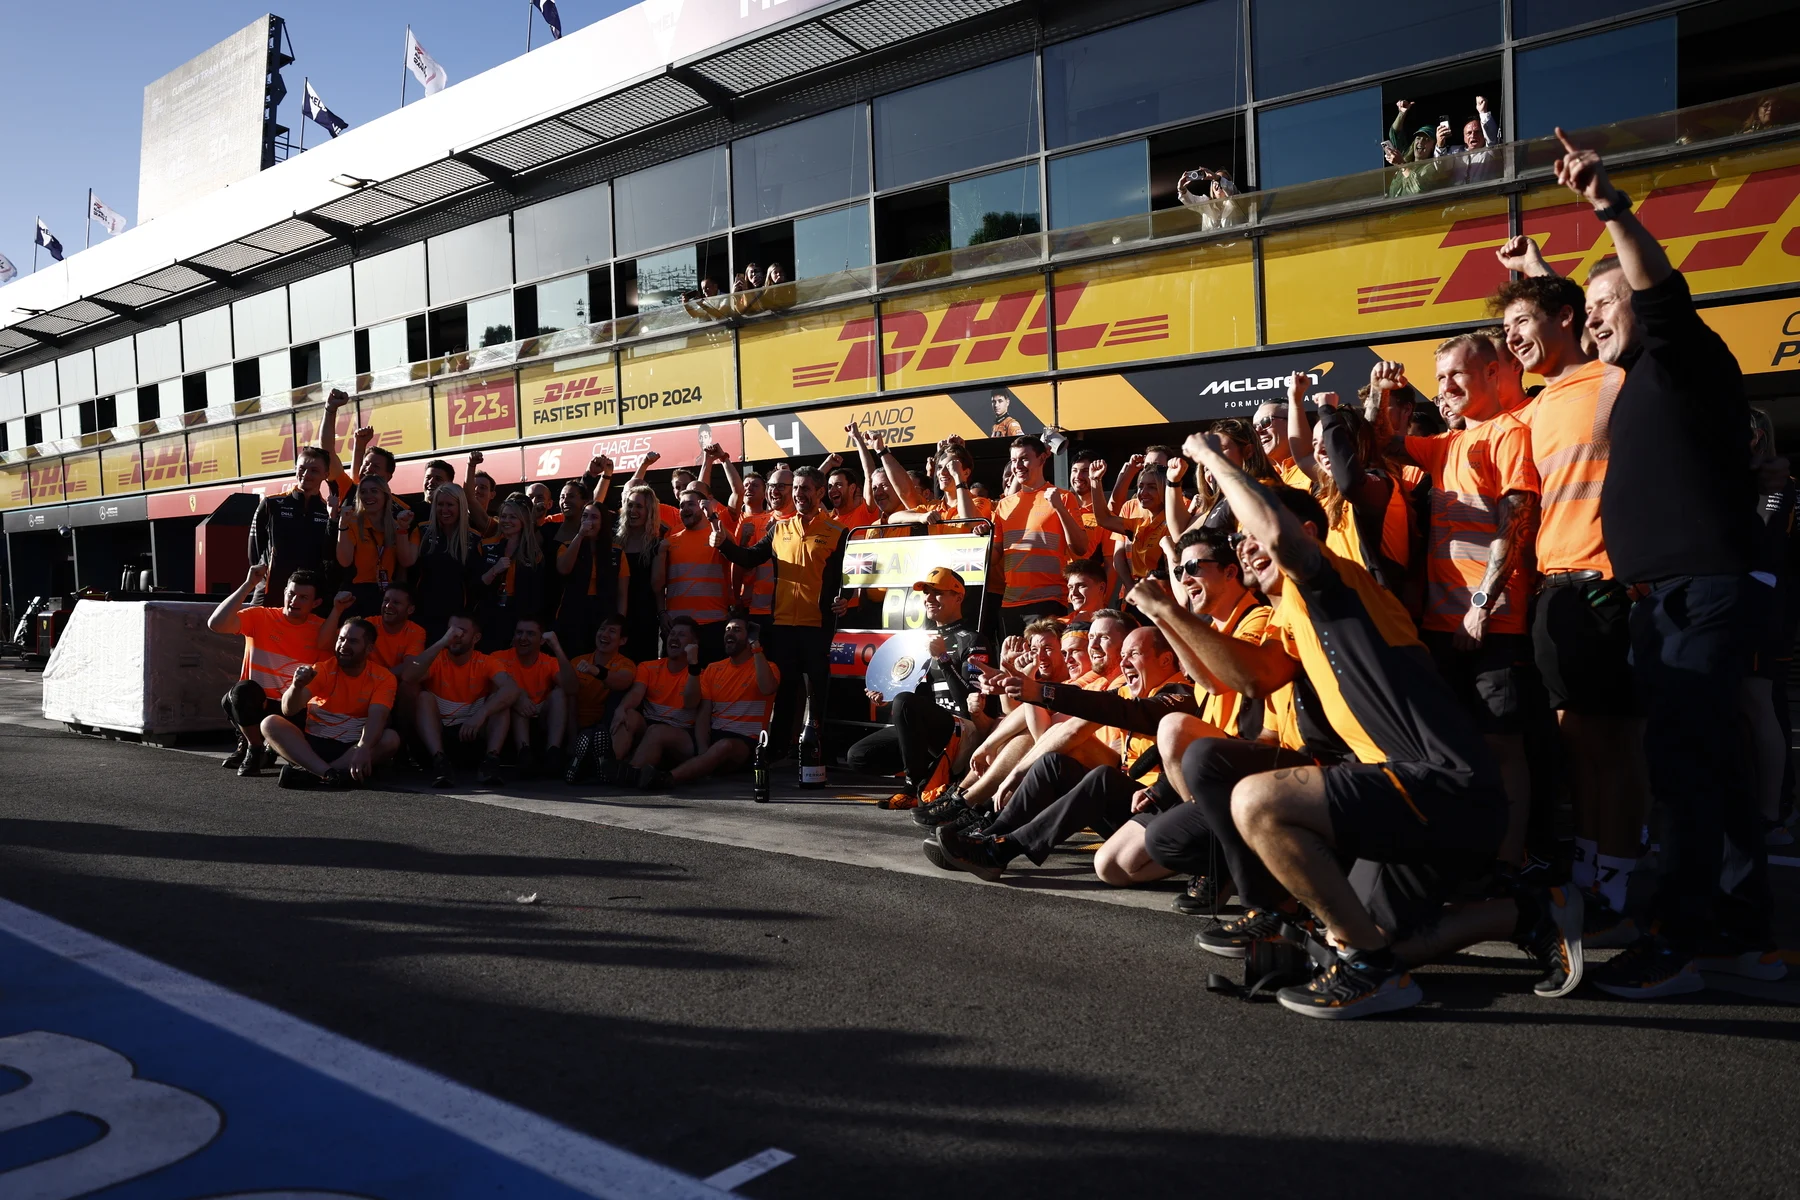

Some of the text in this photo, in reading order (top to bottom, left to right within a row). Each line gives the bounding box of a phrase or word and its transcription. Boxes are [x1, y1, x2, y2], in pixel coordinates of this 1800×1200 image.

[1433, 164, 1800, 305] DH
[834, 281, 1110, 383] DHL
[533, 386, 703, 425] FASTEST PIT STOP 2024
[543, 376, 602, 404] DHL
[279, 408, 382, 463] DHL
[848, 406, 914, 430] LANDO
[130, 442, 204, 485] DHL
[536, 448, 563, 477] 16
[592, 436, 652, 457] CHARLES
[20, 463, 75, 500] DHL
